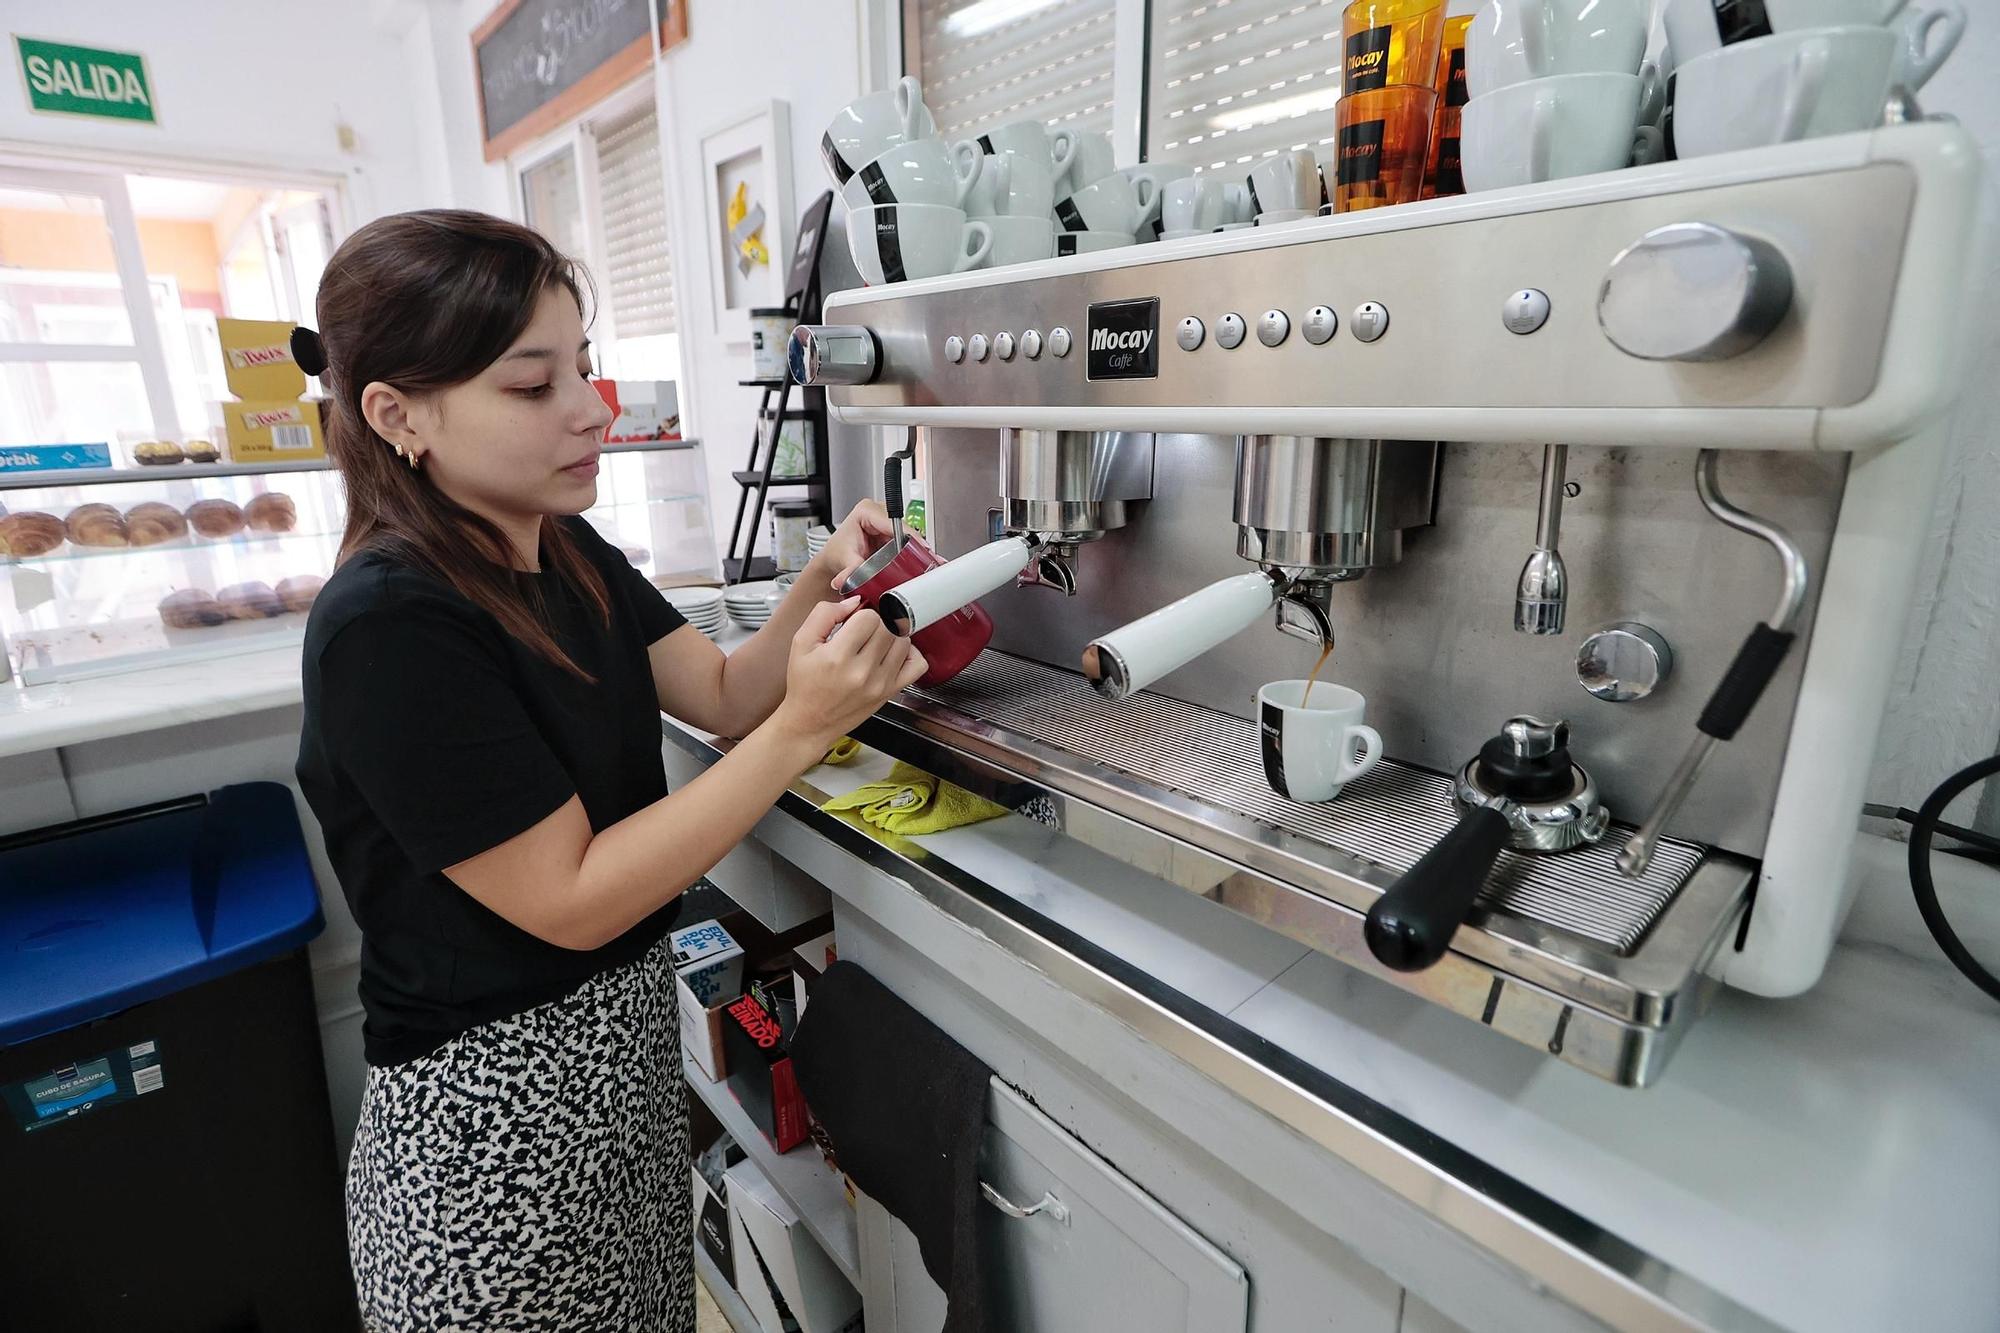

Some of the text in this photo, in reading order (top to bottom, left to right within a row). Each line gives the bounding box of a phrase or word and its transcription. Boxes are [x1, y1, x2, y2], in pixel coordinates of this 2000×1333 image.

[1347, 50, 1384, 70] Mocay
[27, 54, 150, 106] SALIDA
[1341, 143, 1377, 158] Mocay
[1090, 327, 1154, 354] Mocay
[676, 934, 692, 948] TE
[687, 931, 709, 951] RAN
[698, 928, 714, 941] CO
[708, 925, 732, 948] EDUL
[727, 1001, 776, 1048] EINADO
